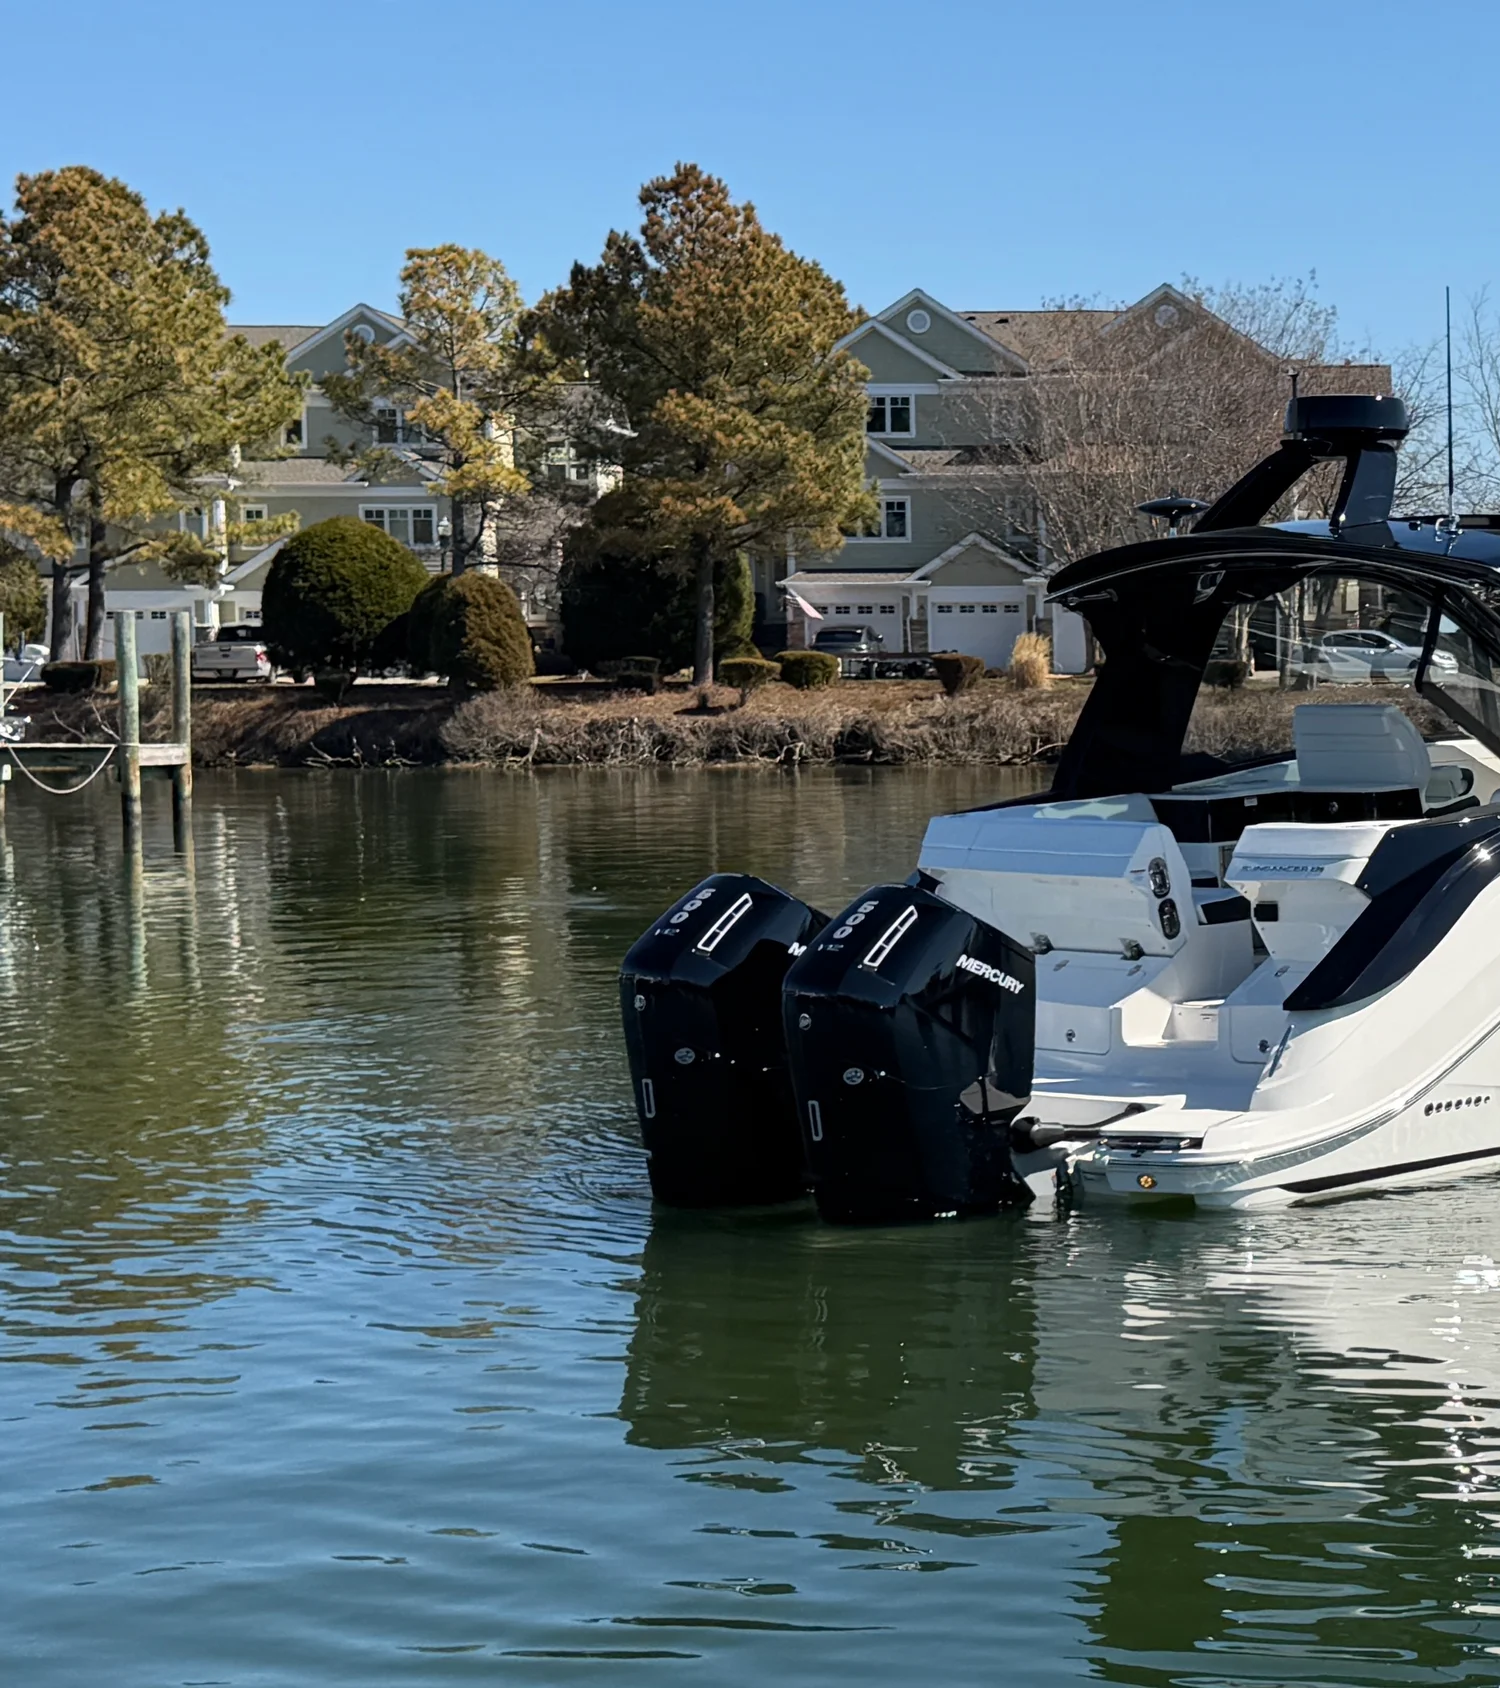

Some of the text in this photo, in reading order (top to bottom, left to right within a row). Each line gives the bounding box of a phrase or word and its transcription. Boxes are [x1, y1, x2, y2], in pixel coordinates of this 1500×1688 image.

[669, 888, 717, 924] 600
[832, 900, 880, 939] 600
[955, 954, 1025, 994] MERCURY
